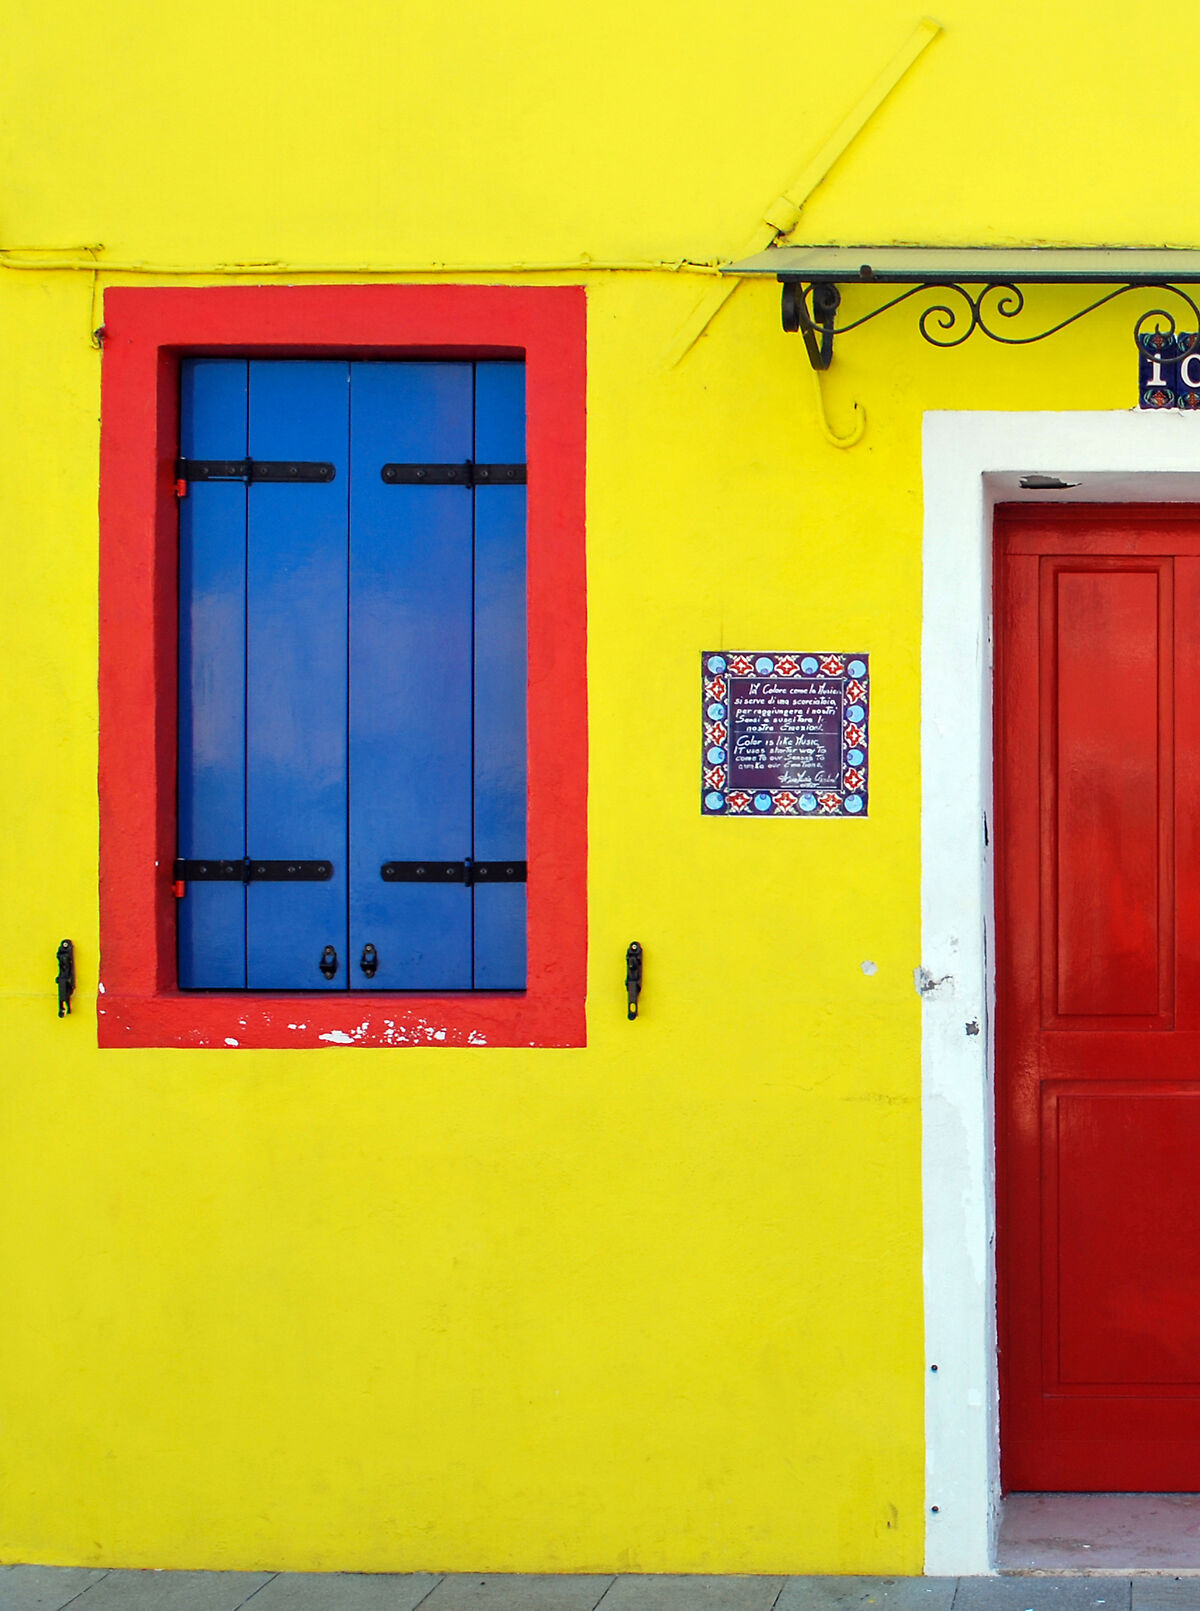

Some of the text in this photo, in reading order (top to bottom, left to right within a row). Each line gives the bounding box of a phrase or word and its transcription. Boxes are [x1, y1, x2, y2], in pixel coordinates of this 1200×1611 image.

[762, 683, 787, 695] Colore
[808, 683, 817, 694] la
[734, 696, 743, 704] si
[767, 695, 777, 705] di
[735, 708, 752, 718] per
[753, 707, 803, 717] raggiungere
[811, 706, 838, 715] nostri
[735, 714, 762, 723] Sensi
[773, 715, 813, 723] suscitare
[746, 723, 774, 732] nostre
[736, 735, 762, 746] Color
[776, 735, 793, 746] like
